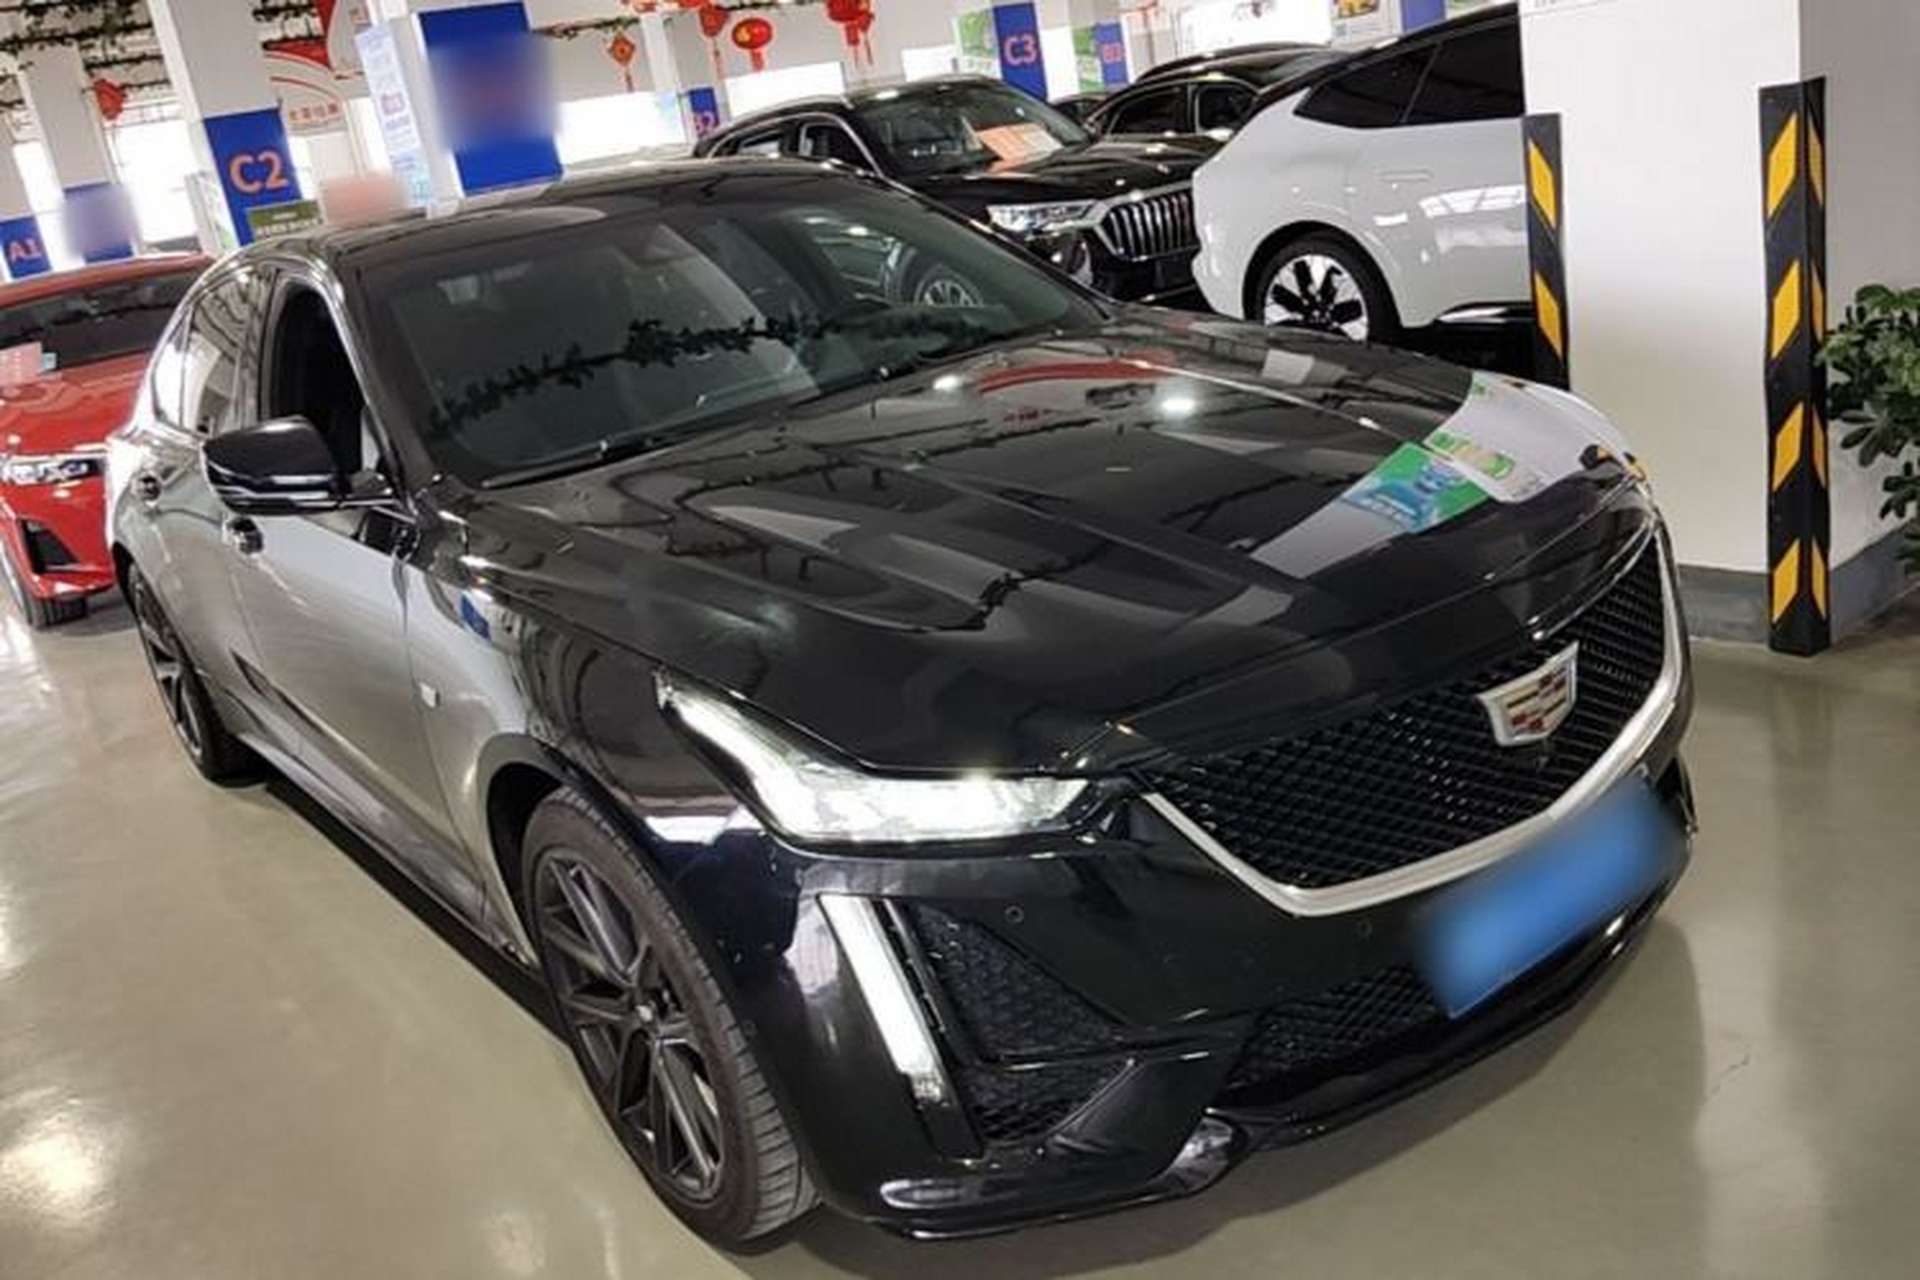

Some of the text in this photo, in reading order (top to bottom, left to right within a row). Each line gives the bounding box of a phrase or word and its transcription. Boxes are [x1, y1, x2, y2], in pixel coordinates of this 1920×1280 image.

[1003, 33, 1037, 65] C3
[230, 151, 288, 192] C2
[9, 238, 41, 262] A1
